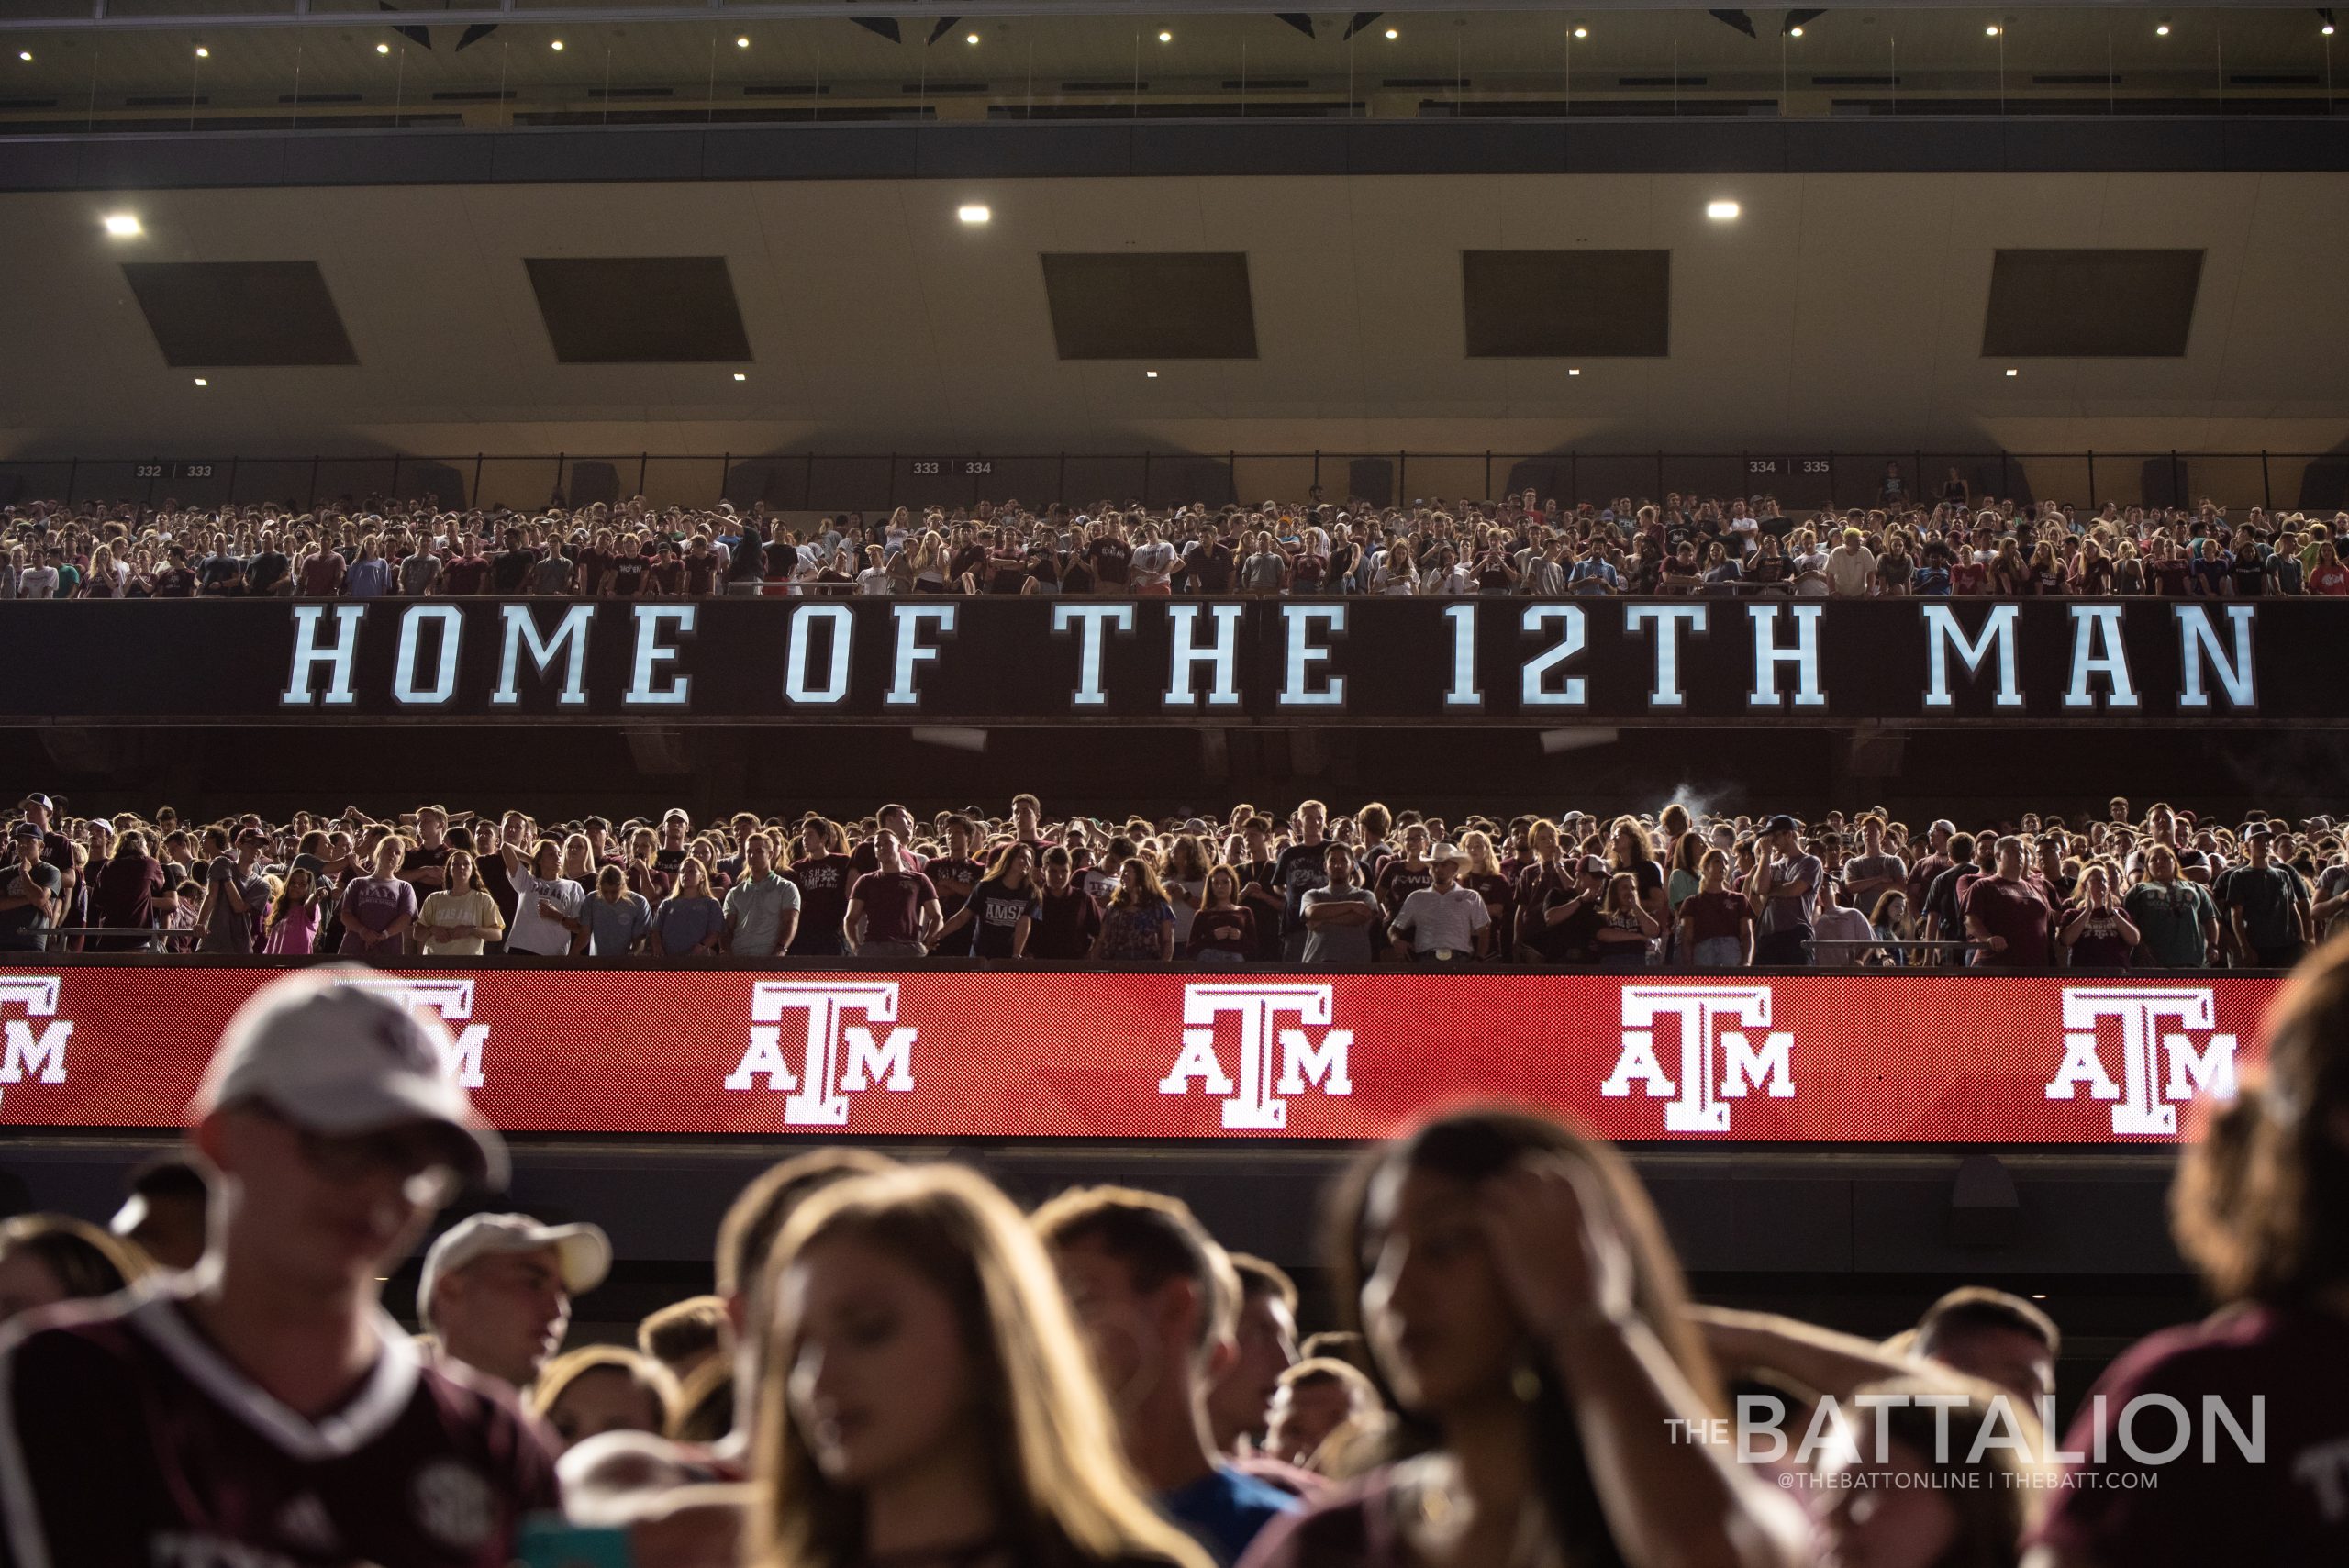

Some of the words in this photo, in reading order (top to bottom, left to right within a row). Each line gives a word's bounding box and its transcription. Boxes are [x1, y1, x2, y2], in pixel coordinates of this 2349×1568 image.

[137, 465, 161, 477] 332
[187, 465, 212, 477] 333
[913, 462, 939, 474] 333
[965, 462, 992, 474] 334
[1749, 461, 1776, 473] 334
[1803, 461, 1830, 473] 335
[283, 606, 696, 705] HOME
[785, 605, 955, 705] OF
[1053, 605, 1345, 705] THE
[1445, 605, 1825, 705] 12TH
[1922, 605, 2254, 706] MAN
